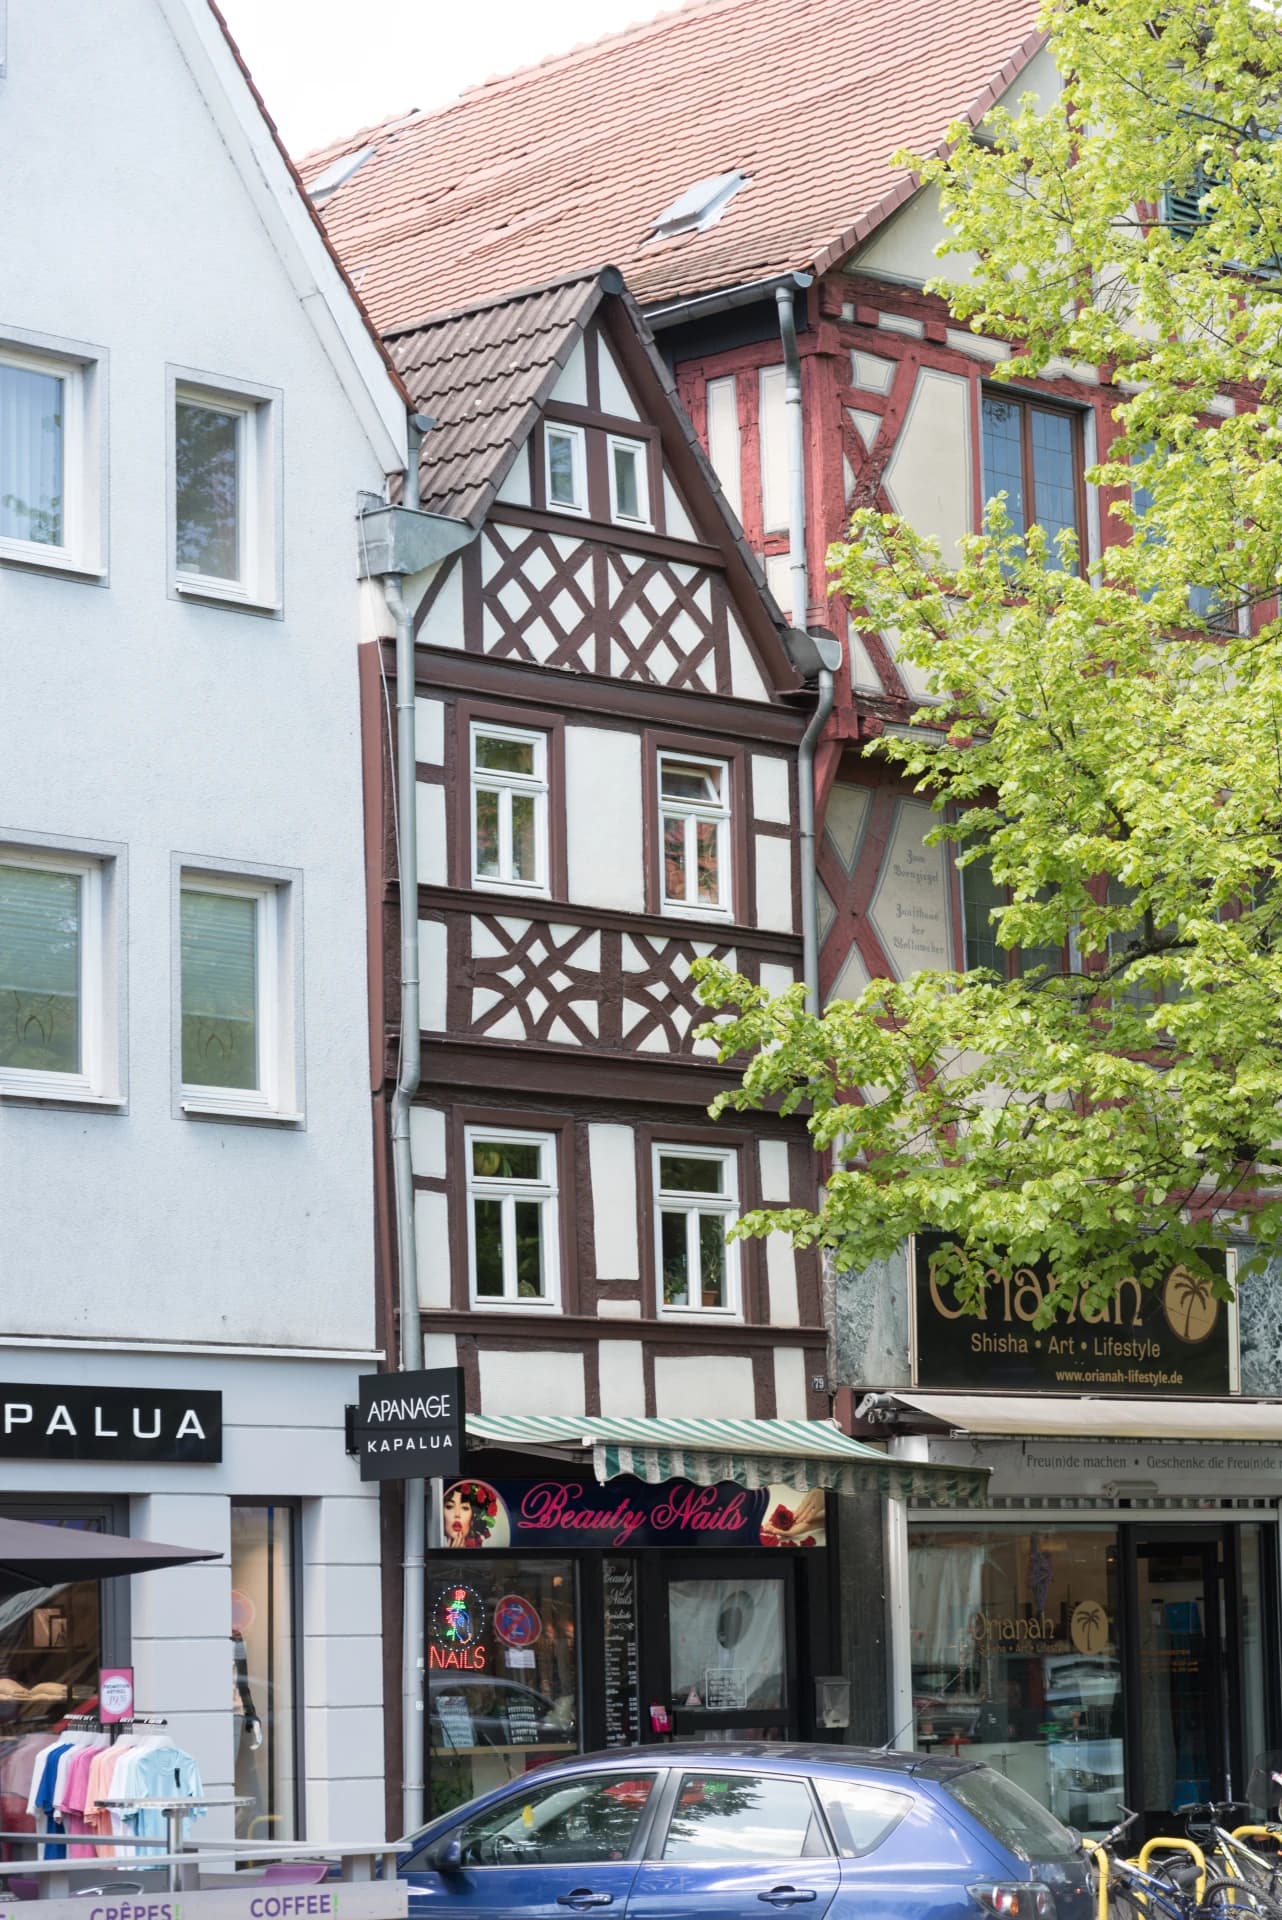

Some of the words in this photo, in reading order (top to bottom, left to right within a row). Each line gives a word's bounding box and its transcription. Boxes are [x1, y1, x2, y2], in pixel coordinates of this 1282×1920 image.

[970, 1331, 1029, 1353] Shisha
[1048, 1335, 1074, 1355] Art
[1094, 1336, 1161, 1360] Lifestyle
[1055, 1368, 1184, 1387] www.orianah-lifestyle.de
[367, 1394, 451, 1423] APANAGE
[367, 1434, 453, 1453] KAPALUA
[1026, 1454, 1080, 1470] Freu(n)de
[1083, 1456, 1126, 1469] machen
[1146, 1455, 1205, 1469] Geschenke
[1208, 1456, 1225, 1469] die
[517, 1482, 647, 1546] Beauty
[651, 1485, 748, 1530] Nails
[250, 1894, 339, 1918] COFFEE!
